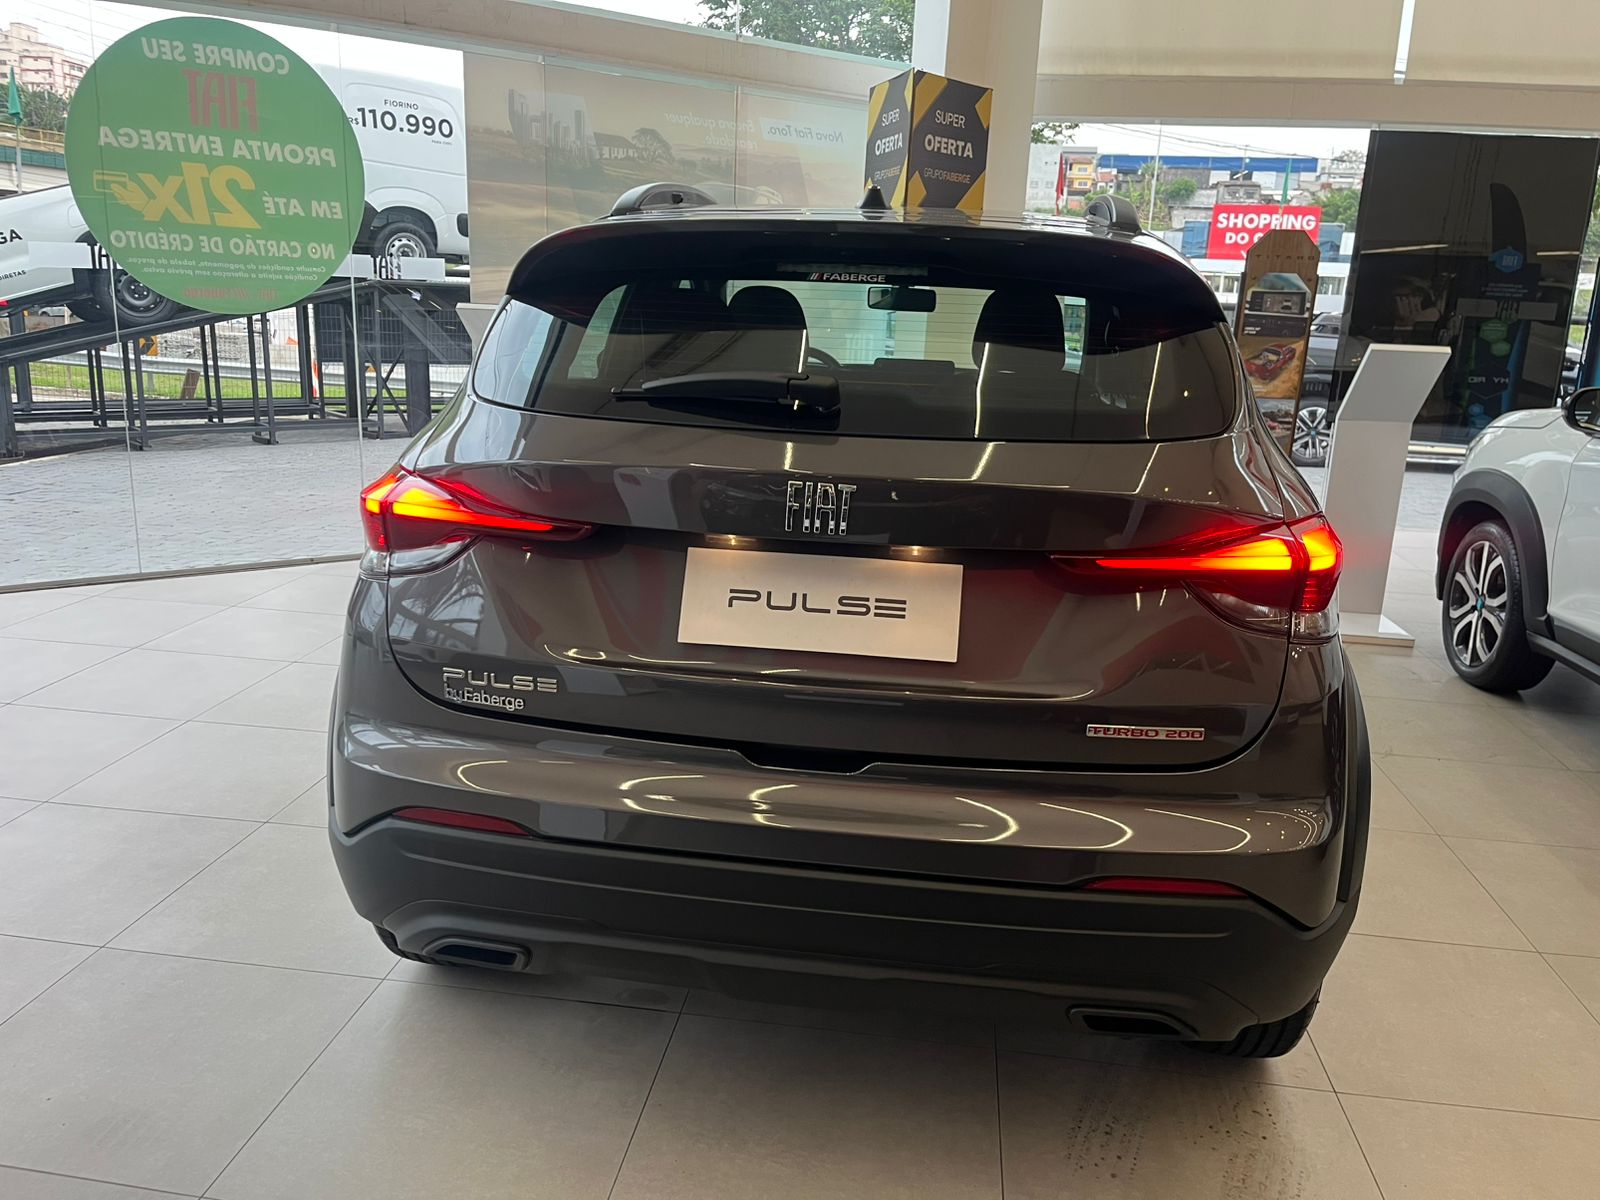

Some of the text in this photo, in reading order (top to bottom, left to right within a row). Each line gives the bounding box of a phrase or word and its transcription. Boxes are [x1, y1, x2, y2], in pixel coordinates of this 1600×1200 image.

[384, 99, 419, 110] FIORINO
[881, 108, 900, 127] SUPER
[935, 110, 966, 129] SUPER
[875, 132, 903, 156] OFERTA
[924, 134, 973, 159] OFERTA
[1216, 213, 1317, 230] SHOPPING
[1225, 232, 1249, 244] DO
[823, 273, 886, 283] FABERGE
[785, 480, 857, 536] FIAT
[728, 588, 907, 619] PULSE
[442, 667, 557, 693] PULSE
[464, 687, 525, 711] Faberge
[1089, 726, 1203, 739] TURBO 200
